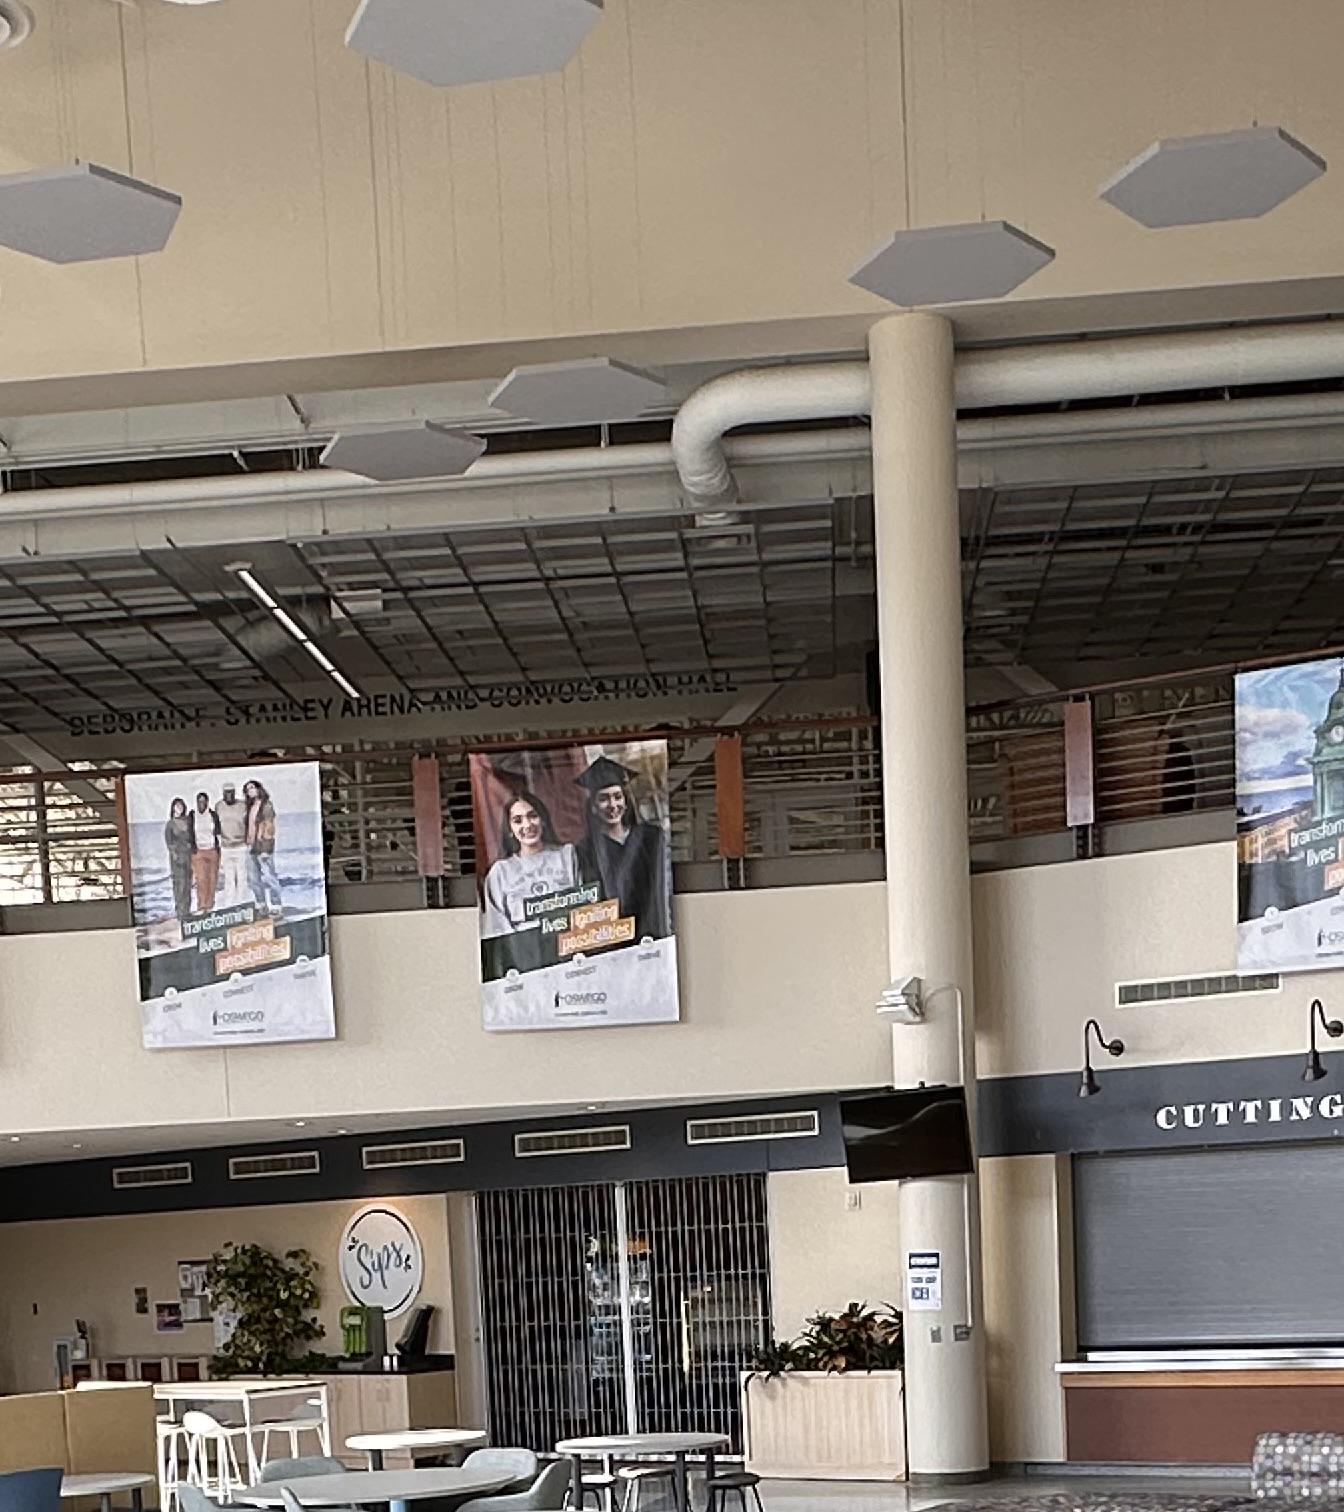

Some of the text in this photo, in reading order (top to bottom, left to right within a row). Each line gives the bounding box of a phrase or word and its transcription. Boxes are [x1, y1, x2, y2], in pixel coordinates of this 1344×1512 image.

[340, 693, 422, 718] ARENA
[1307, 846, 1336, 867] lives
[526, 887, 598, 915] transforming
[183, 908, 253, 934] transforming
[542, 917, 568, 934] lives
[199, 936, 225, 953] lives
[1155, 1094, 1344, 1130] CUTTING
[356, 1241, 404, 1290] Sips
